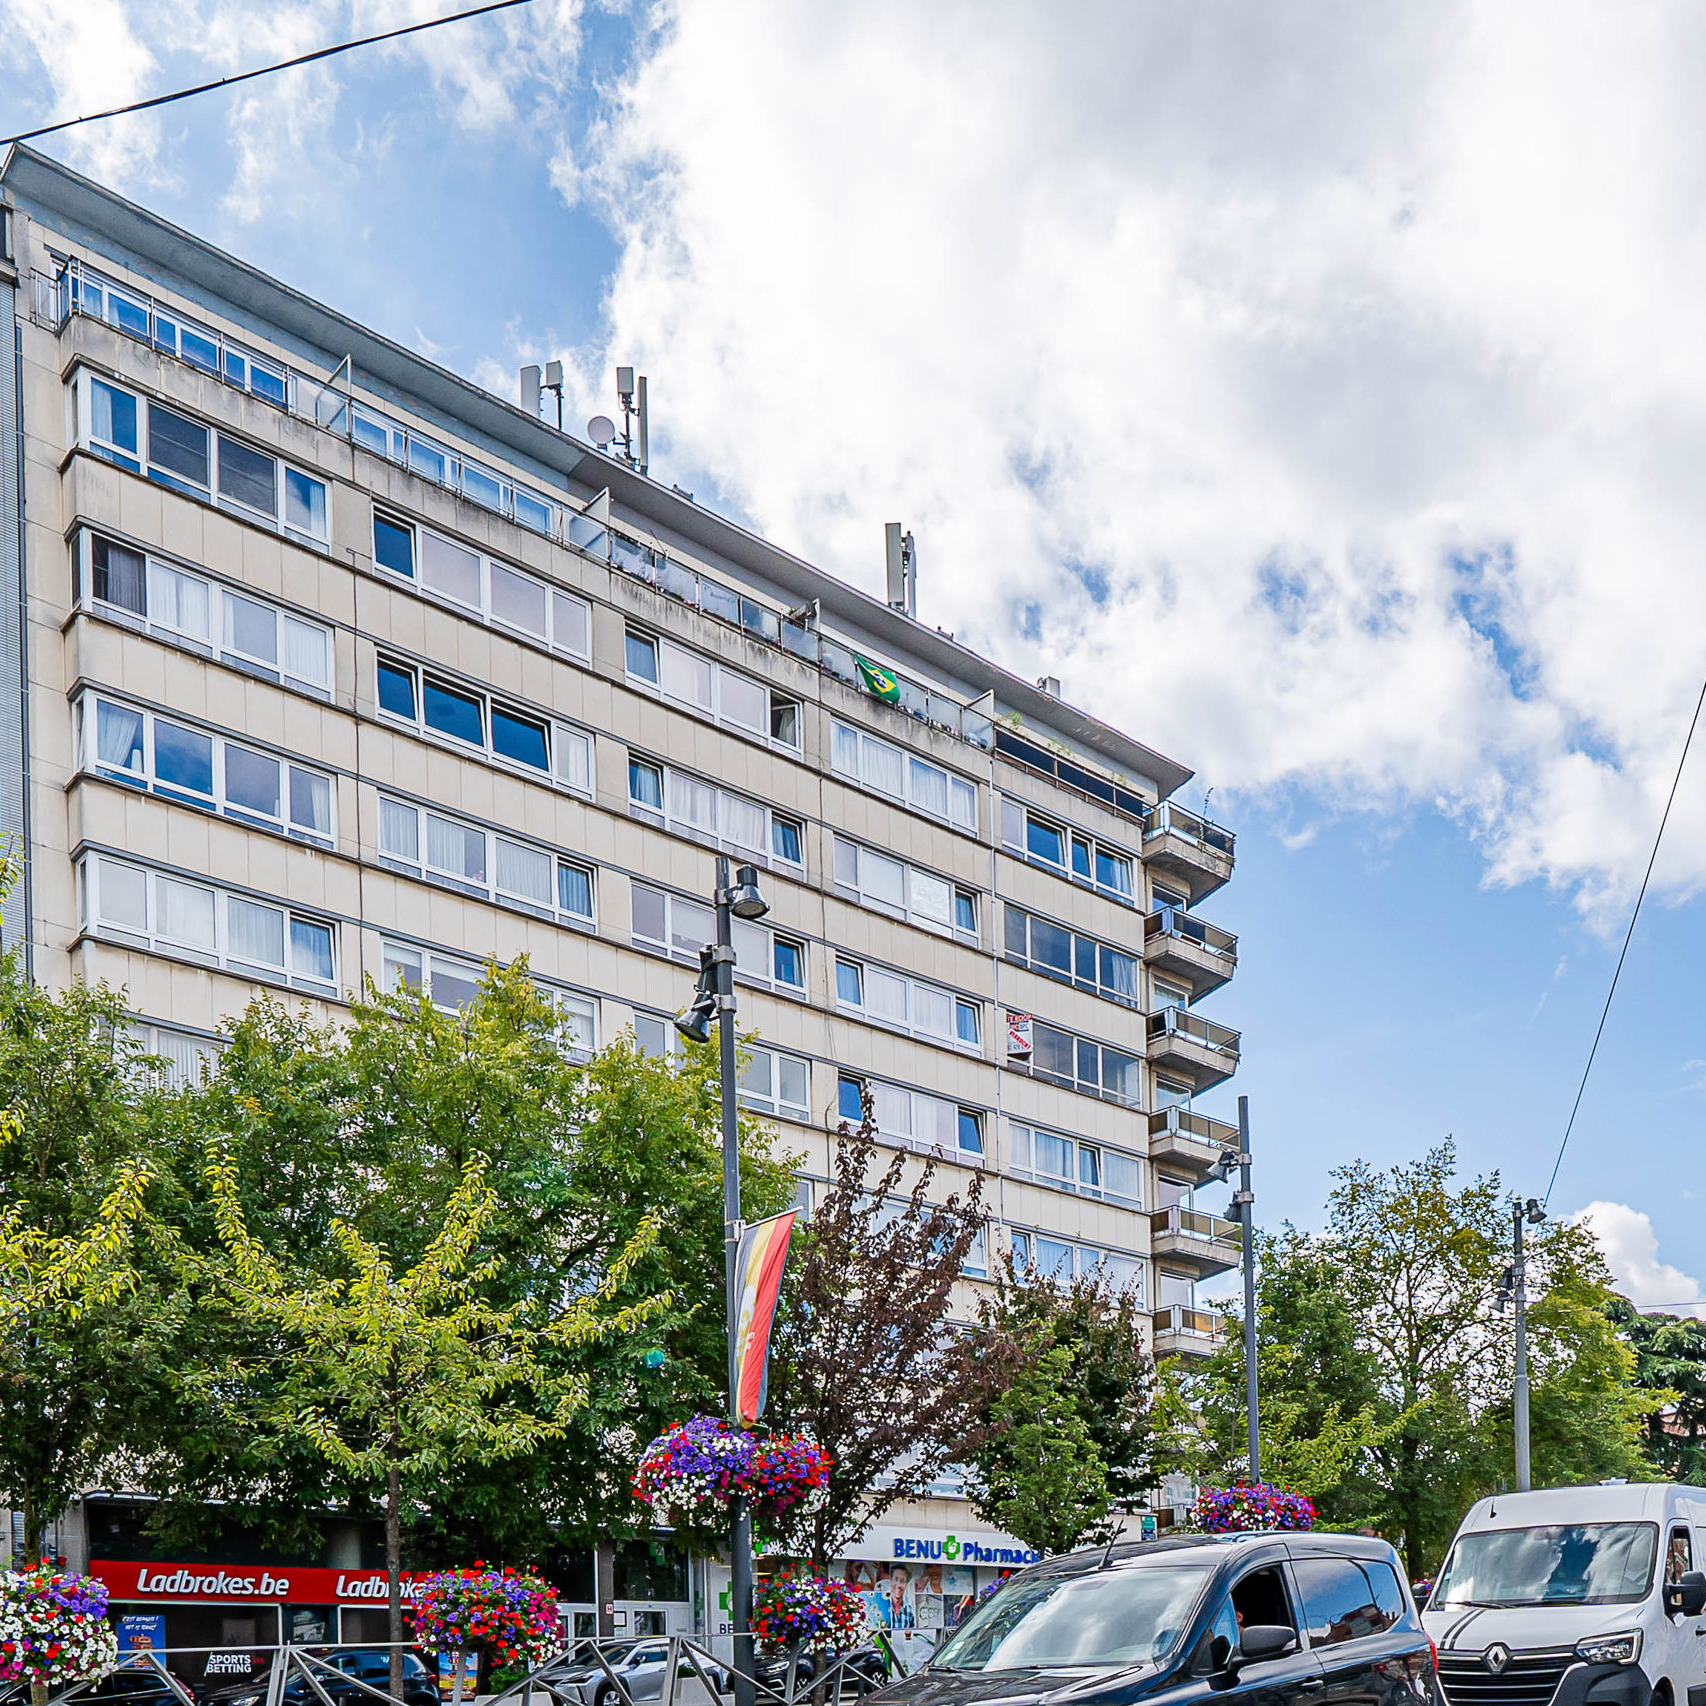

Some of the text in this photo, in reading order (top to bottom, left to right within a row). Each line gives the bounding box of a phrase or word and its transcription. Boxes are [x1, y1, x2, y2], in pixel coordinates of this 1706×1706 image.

[893, 1538, 1041, 1564] BENU Pharmaci
[137, 1568, 290, 1596] Ladbrokes.be
[719, 1624, 733, 1634] BE
[210, 1655, 251, 1664] SPORTS
[207, 1664, 252, 1673] BETTING
